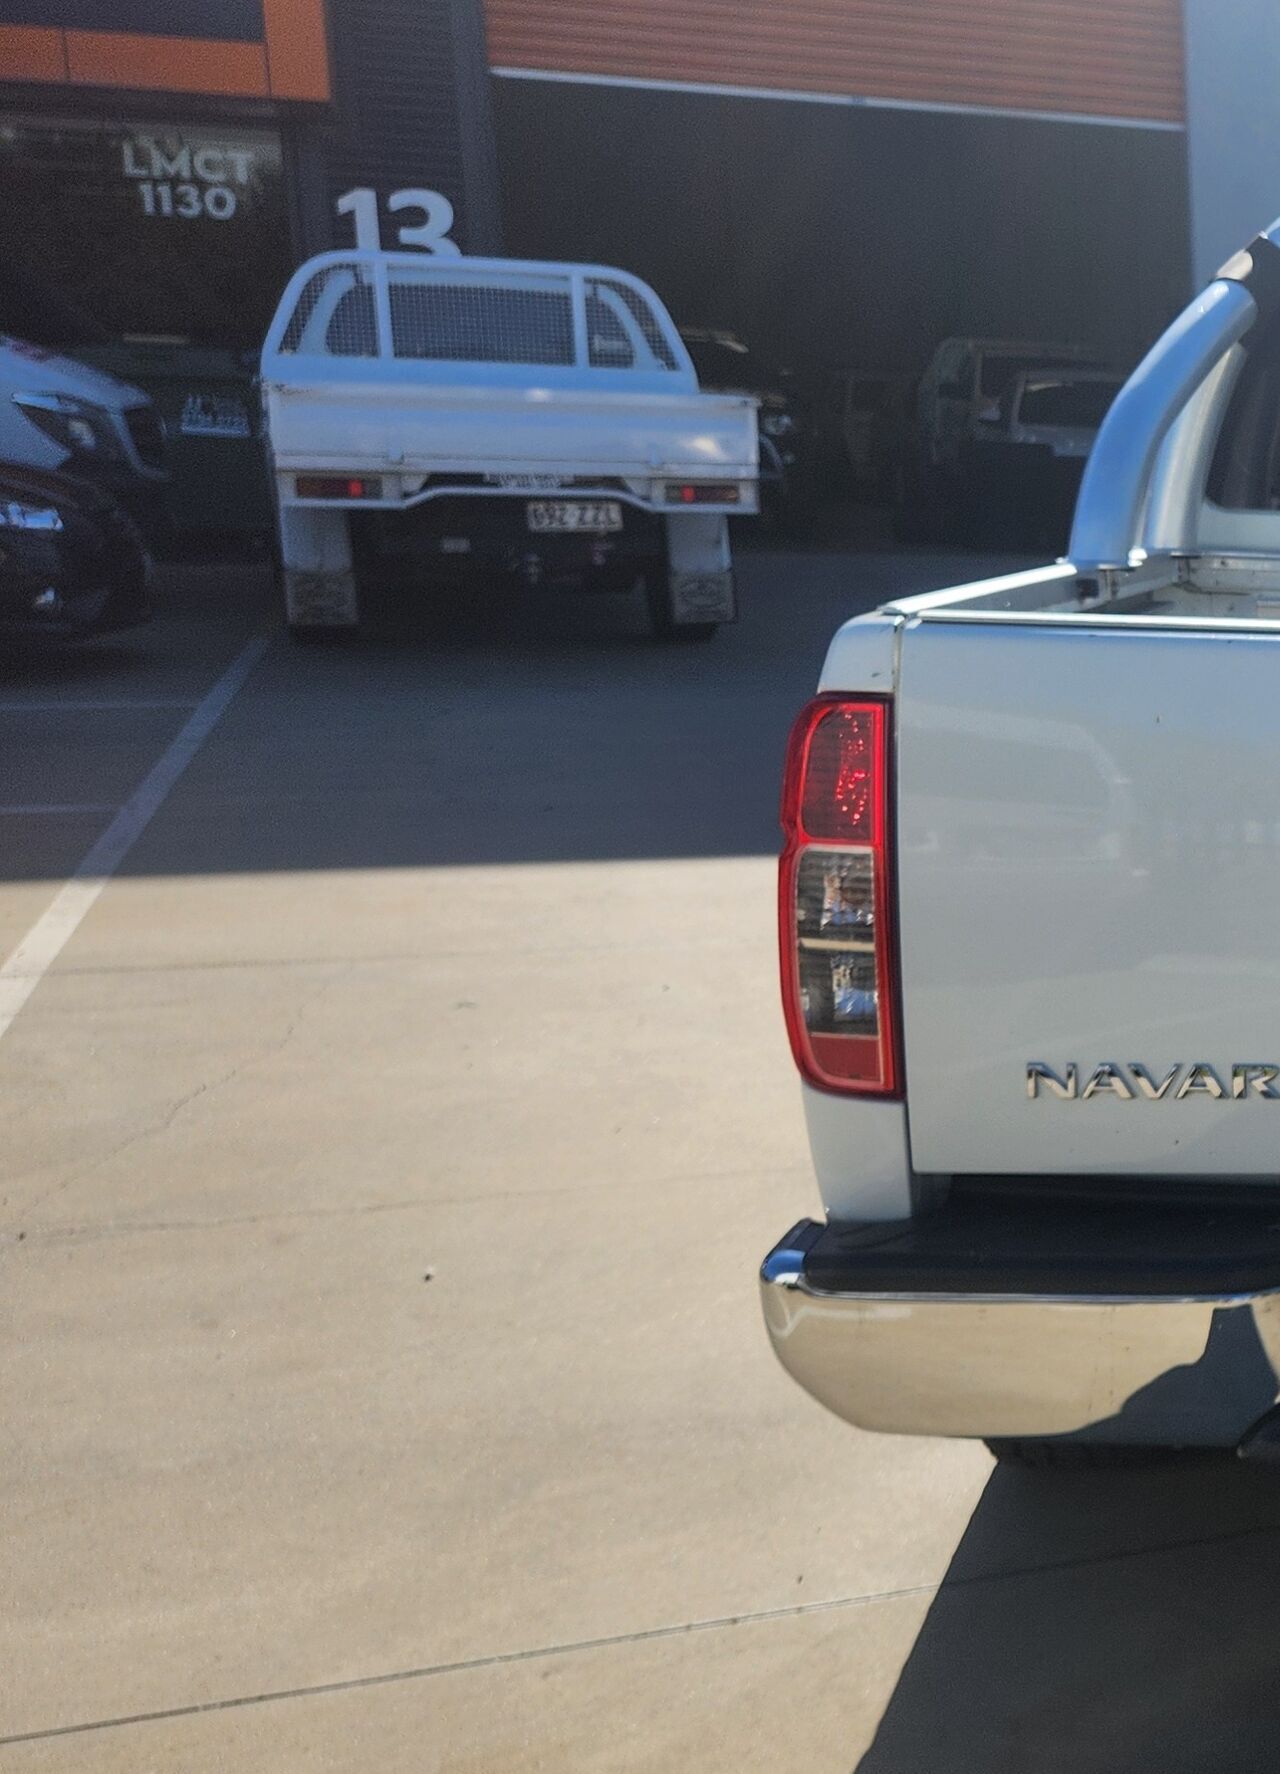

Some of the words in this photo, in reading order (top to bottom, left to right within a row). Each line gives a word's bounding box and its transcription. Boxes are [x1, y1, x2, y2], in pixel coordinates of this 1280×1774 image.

[123, 141, 253, 184] LMCT
[140, 183, 237, 220] 1130
[338, 187, 462, 256] 13
